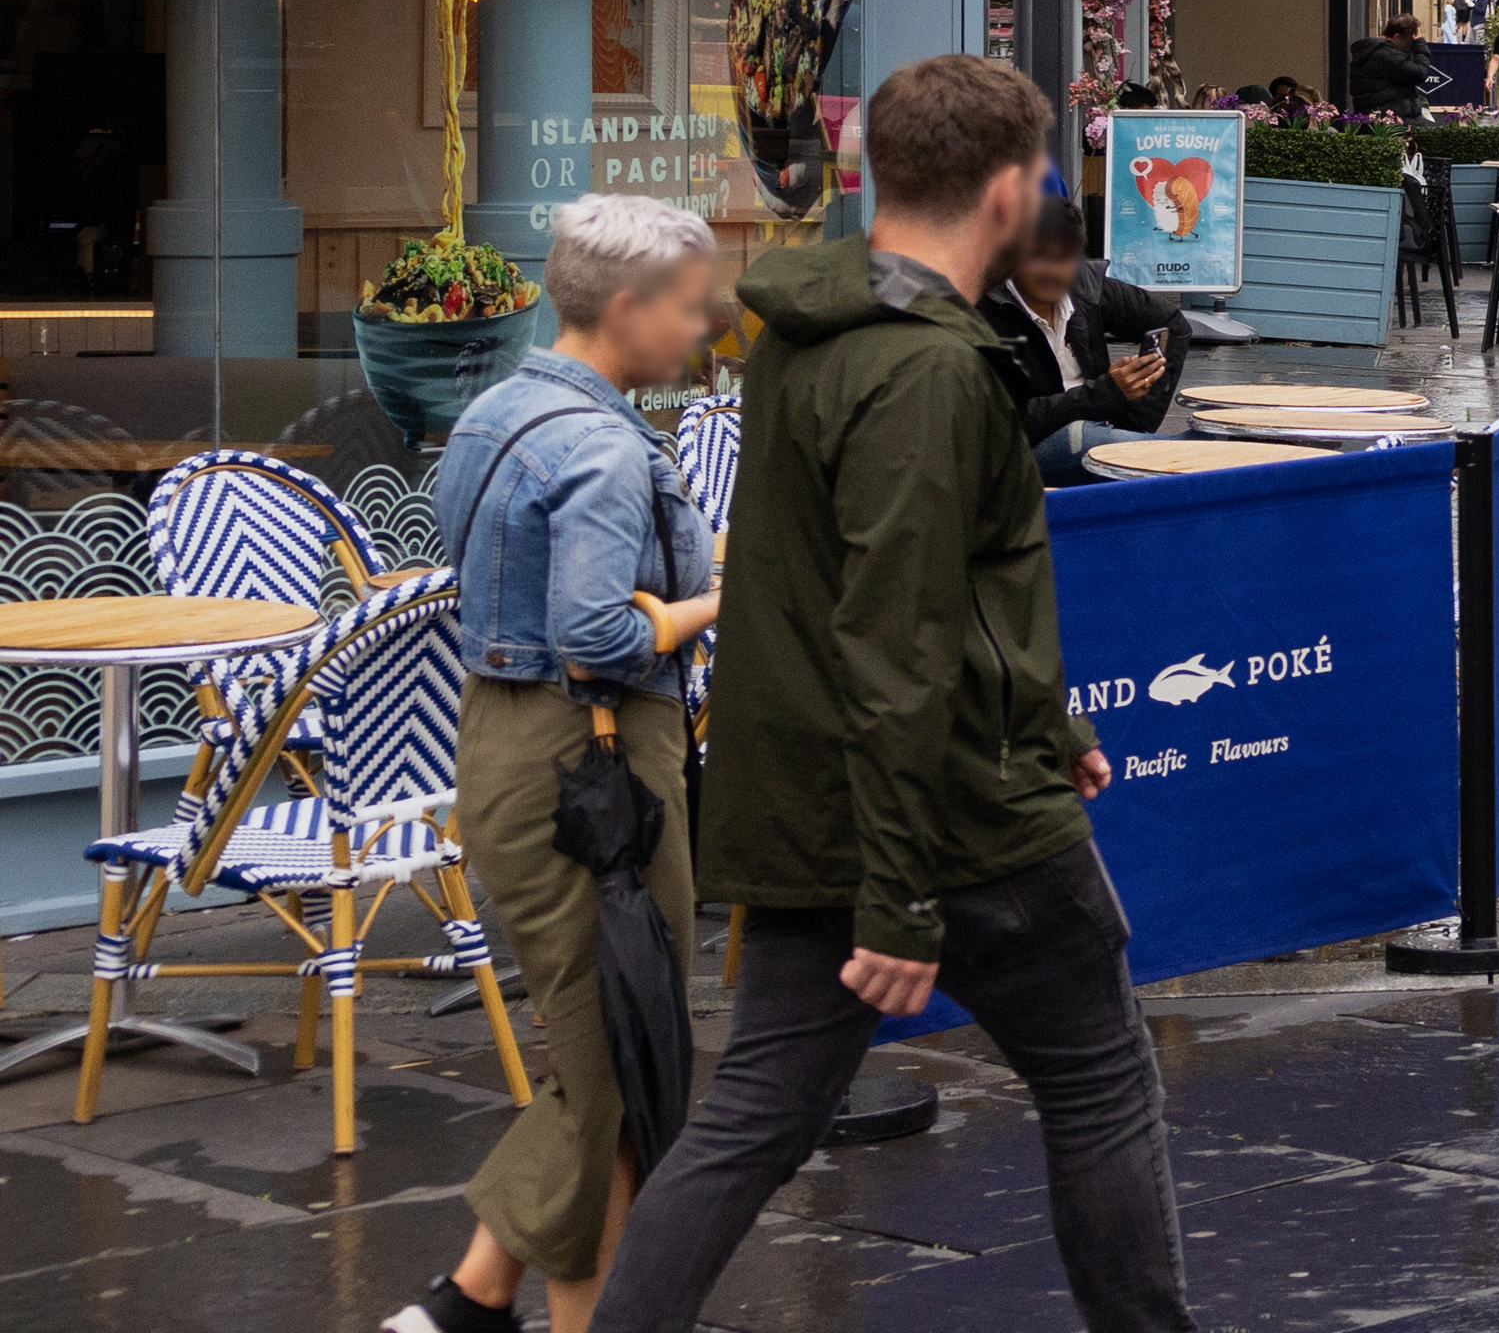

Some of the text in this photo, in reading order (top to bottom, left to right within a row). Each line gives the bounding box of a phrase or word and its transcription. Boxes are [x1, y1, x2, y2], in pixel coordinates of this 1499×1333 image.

[531, 113, 718, 146] ISLAND KATSU
[1135, 134, 1221, 153] LOVE SUSHI
[531, 152, 718, 189] OR PACIFIC
[1066, 635, 1333, 716] AND POKÉ
[1124, 735, 1289, 780] Pacific Flavours
